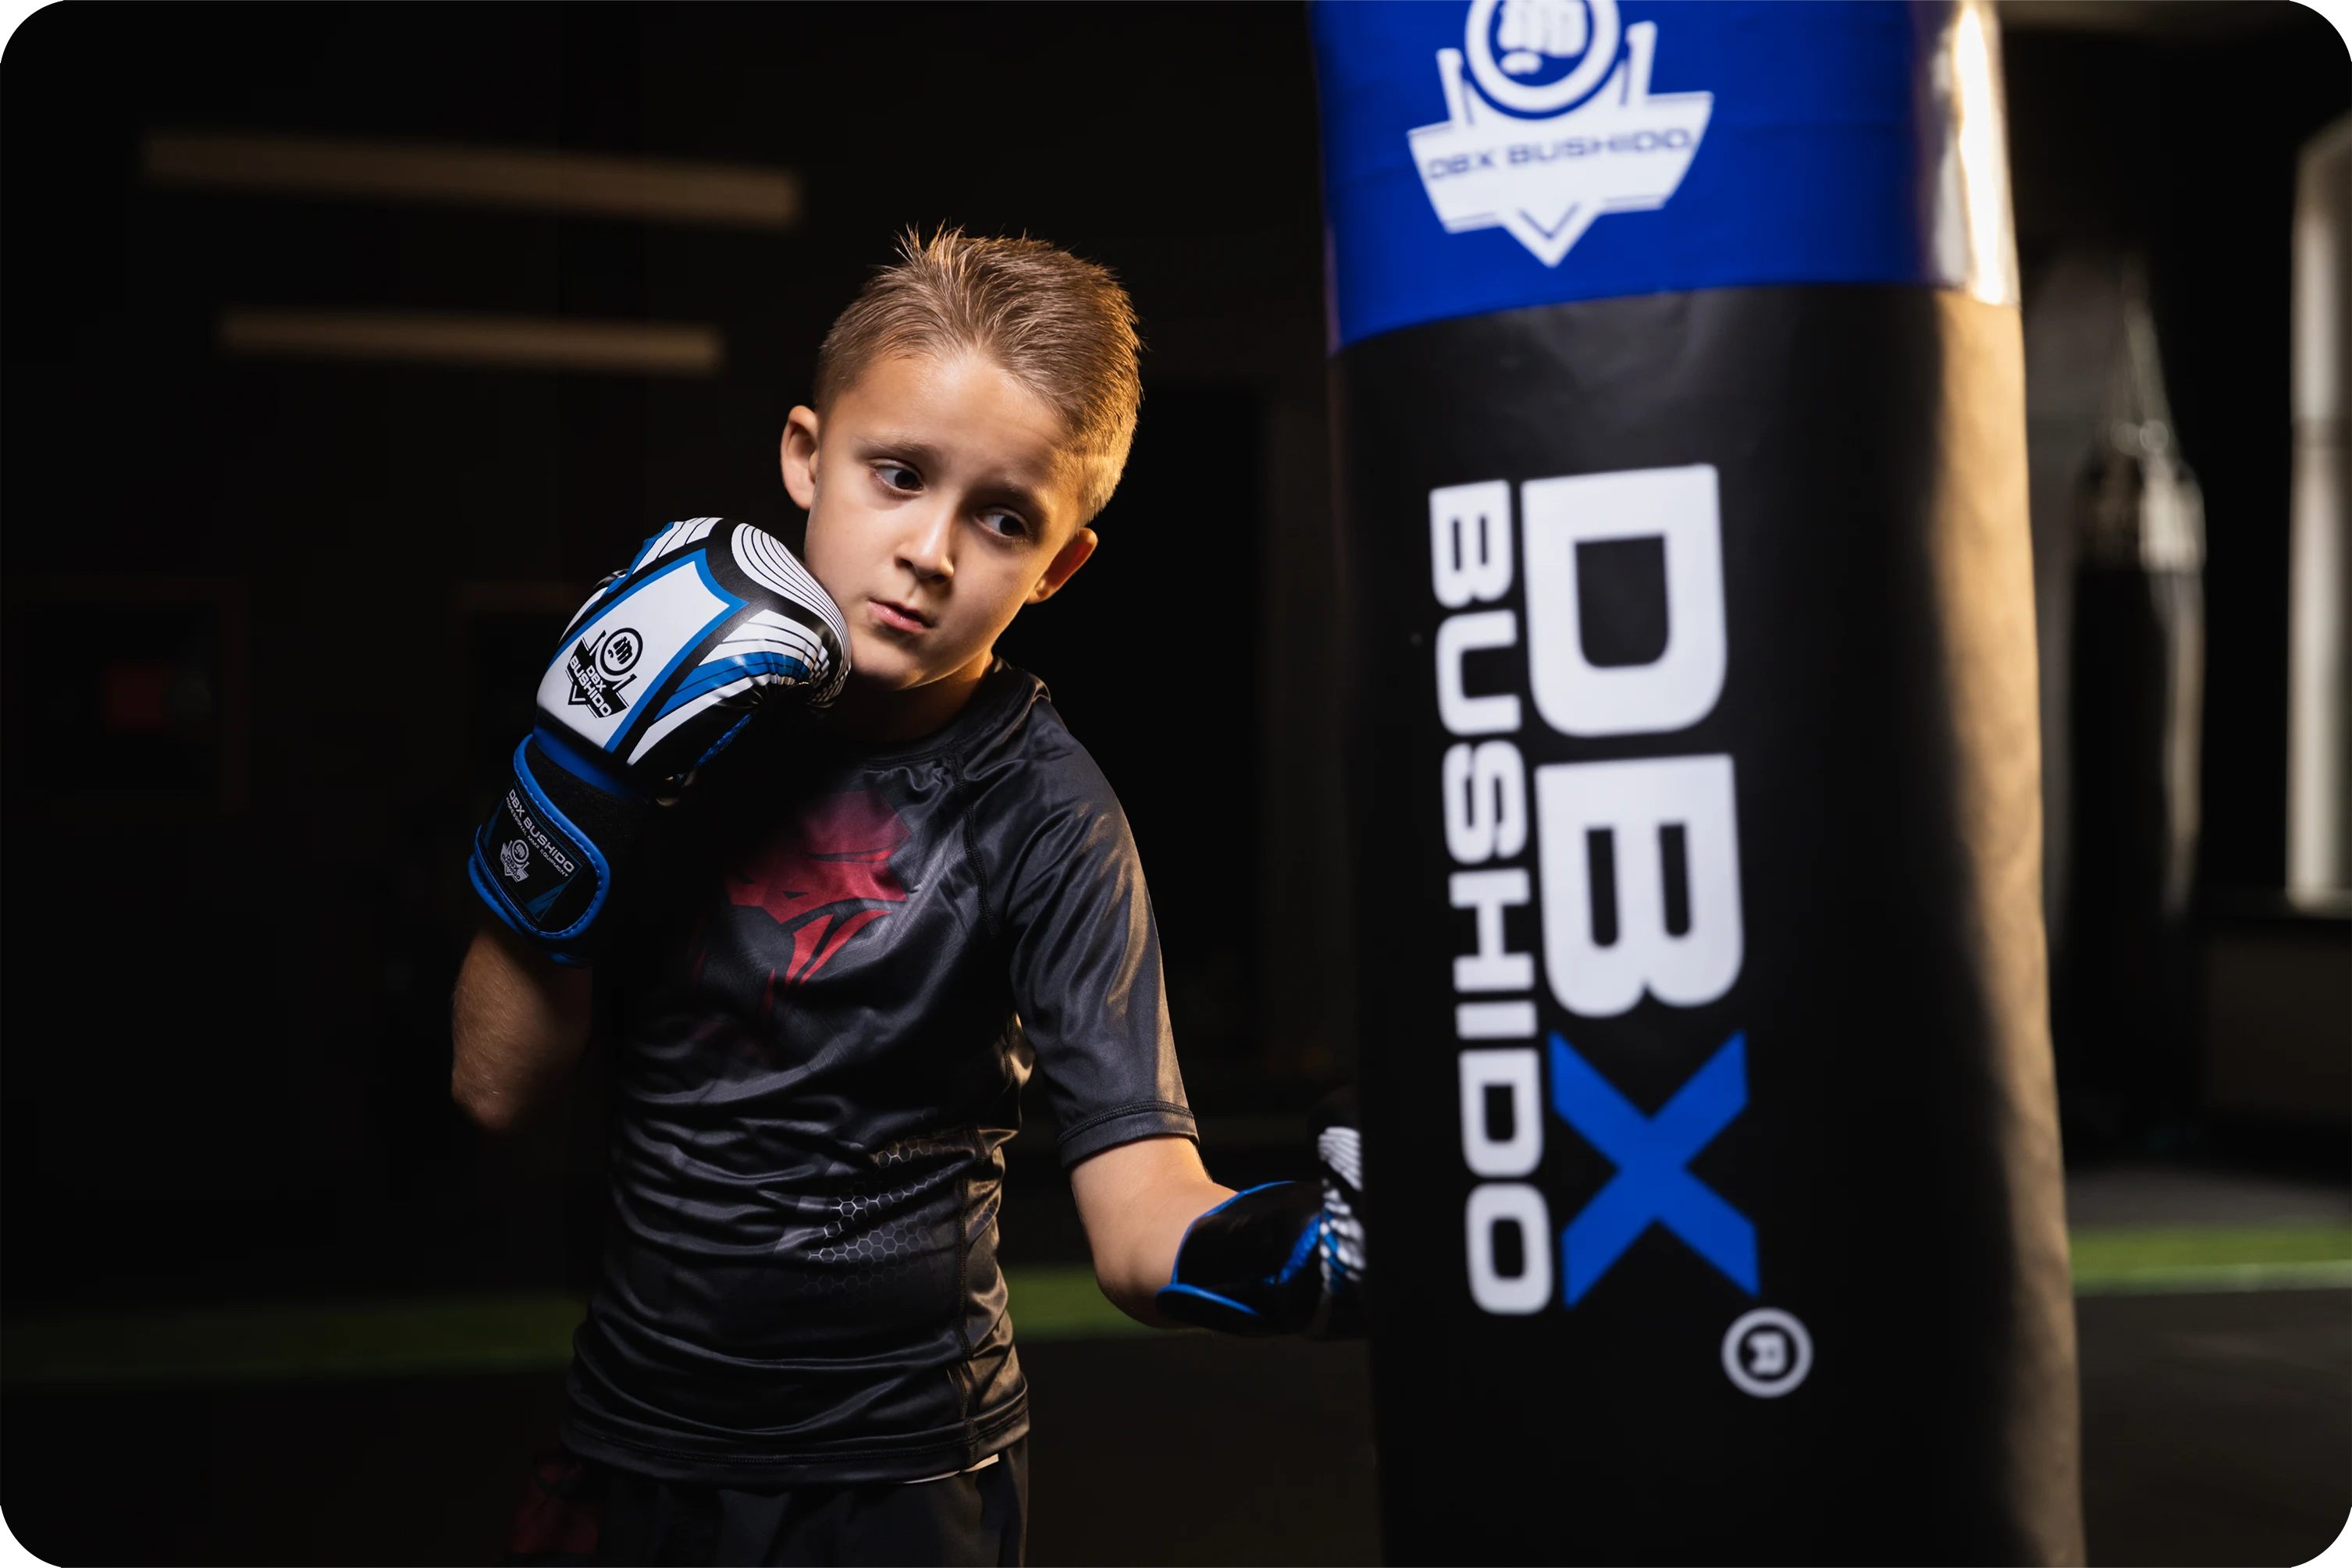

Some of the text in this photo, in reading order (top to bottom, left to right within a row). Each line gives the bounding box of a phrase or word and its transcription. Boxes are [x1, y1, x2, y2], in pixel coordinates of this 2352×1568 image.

[1428, 127, 1693, 180] DBX BUSHIDO
[569, 655, 612, 717] BUSHIDO
[585, 664, 607, 693] DBX
[505, 796, 569, 877] PROFESSIONAL MMA EQUIPMENT
[508, 788, 575, 873] DBX BUSHIDO
[1429, 478, 1553, 1315] BUSHIDO
[1520, 463, 1761, 1310] DBX
